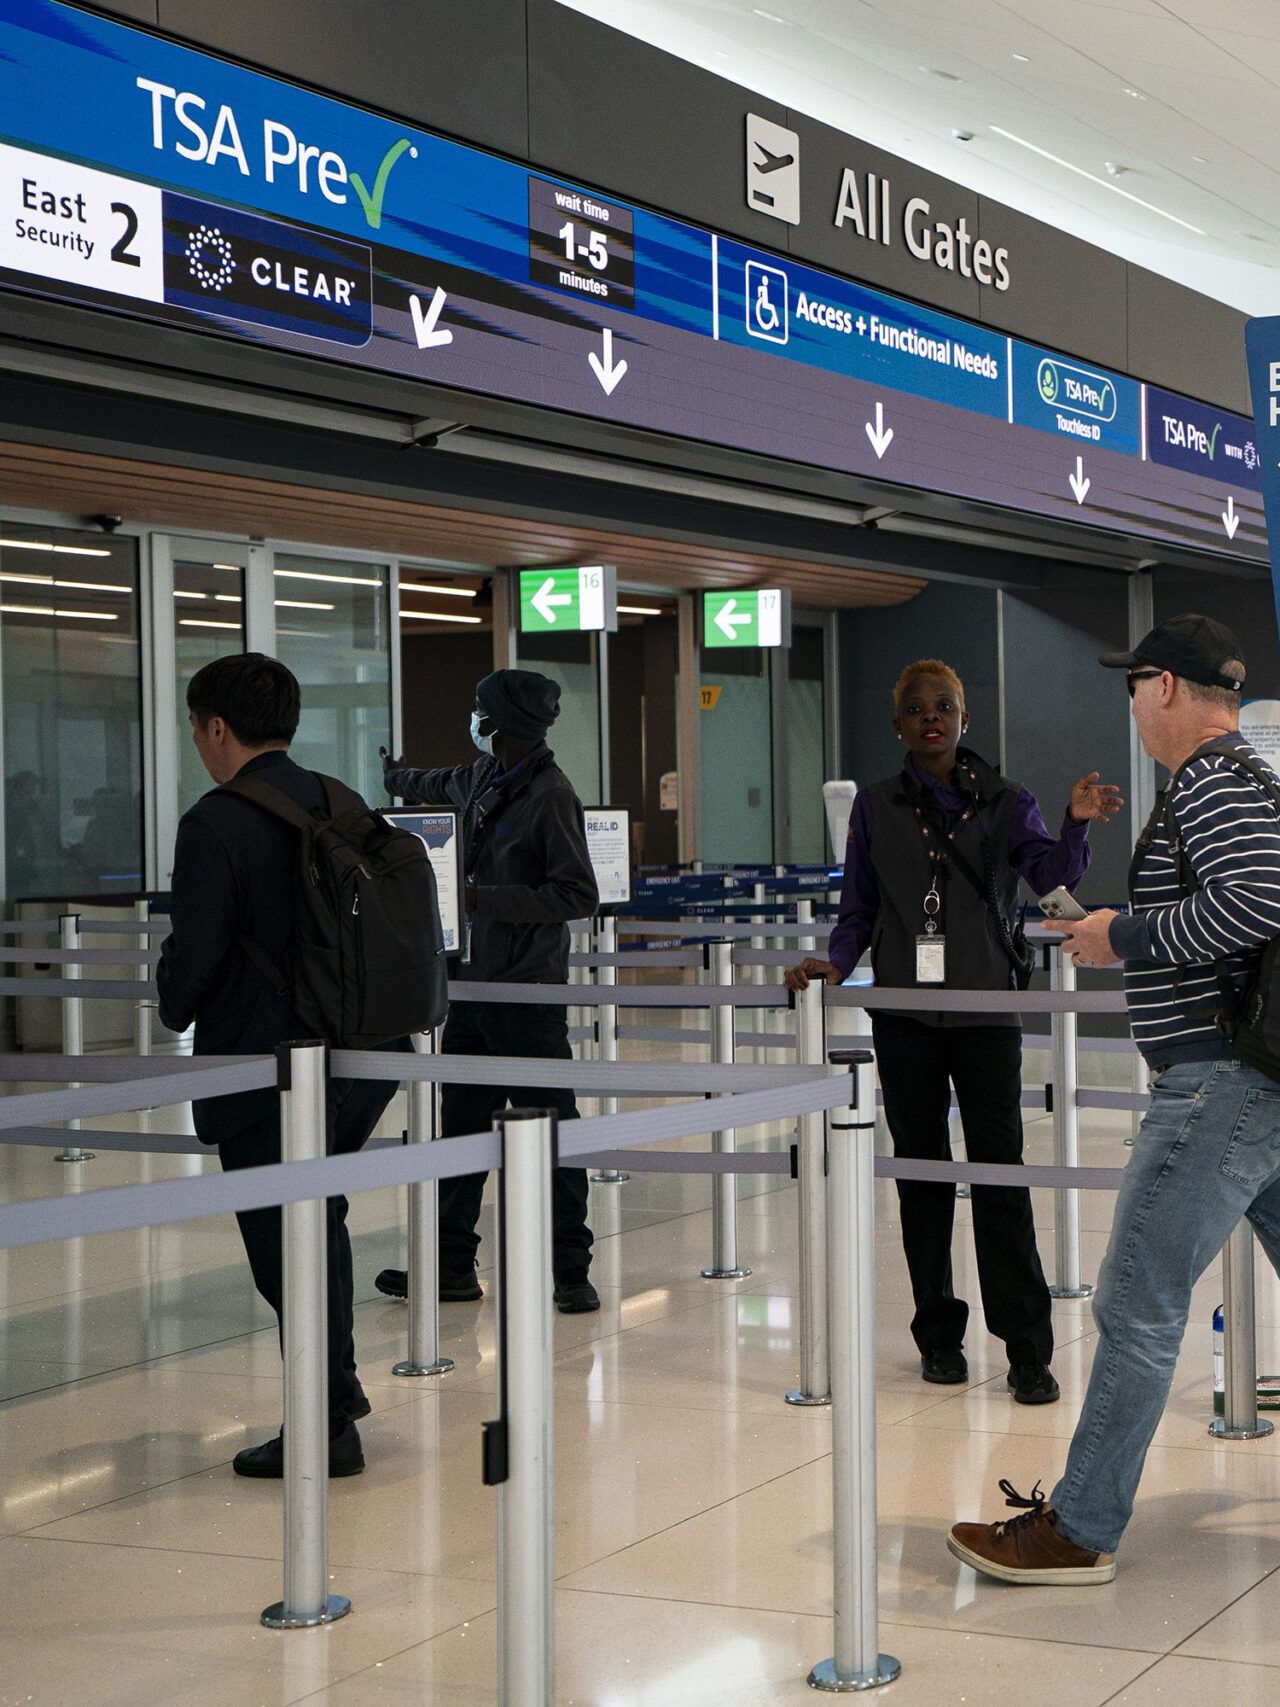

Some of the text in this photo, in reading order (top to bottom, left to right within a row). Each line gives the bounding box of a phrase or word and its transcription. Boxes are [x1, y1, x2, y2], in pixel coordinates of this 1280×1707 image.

[136, 76, 250, 176] TSA
[22, 178, 87, 223] East
[555, 191, 609, 221] wait time
[15, 219, 95, 259] Security
[110, 202, 141, 267] 2
[835, 168, 1011, 291] All Gates
[559, 222, 608, 271] 1-5
[251, 257, 352, 306] CLEAR
[559, 271, 608, 298] minutes
[796, 292, 998, 380] Access + Functional Needs
[1064, 378, 1083, 402] TSA
[1056, 413, 1101, 440] Touchless ID
[1162, 415, 1187, 448] TSA
[1225, 444, 1243, 459] WITH
[583, 573, 600, 589] 16
[762, 595, 777, 610] 17
[702, 691, 712, 705] 17
[422, 825, 451, 834] RIGHTS
[587, 822, 618, 831] REAL ID
